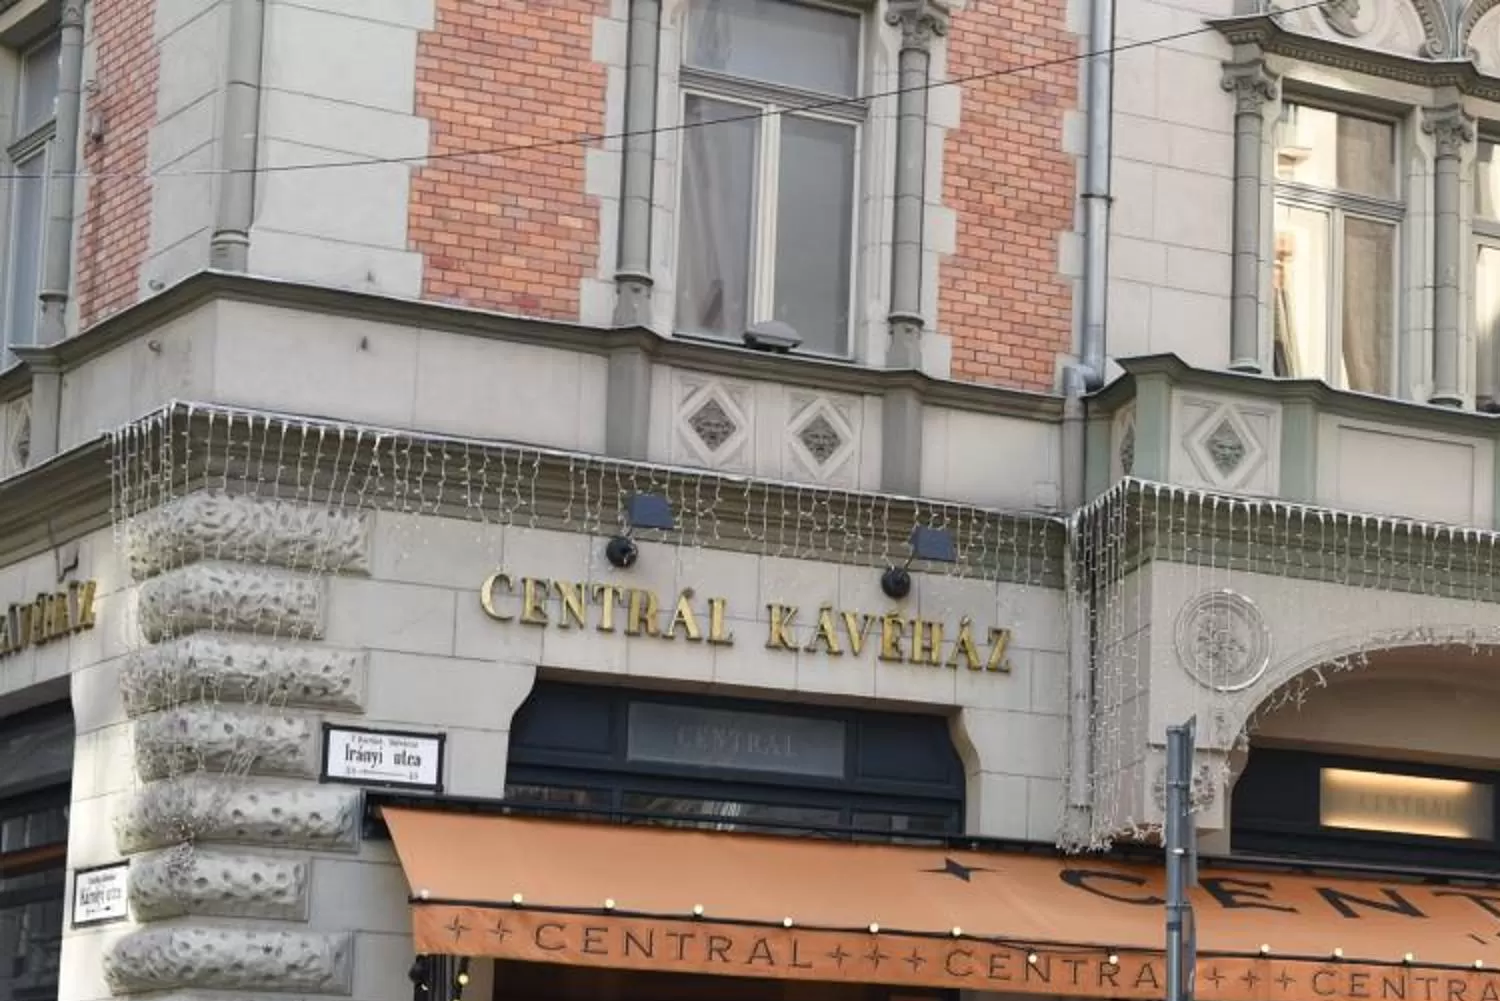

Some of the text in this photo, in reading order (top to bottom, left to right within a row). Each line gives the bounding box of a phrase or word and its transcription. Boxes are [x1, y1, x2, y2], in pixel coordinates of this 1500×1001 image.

[480, 571, 1012, 673] CENTRÁL KÁVÉHÁZ
[345, 743, 383, 768] Irányi
[534, 922, 812, 968] CENTRAL
[945, 949, 1160, 988] CENTRA
